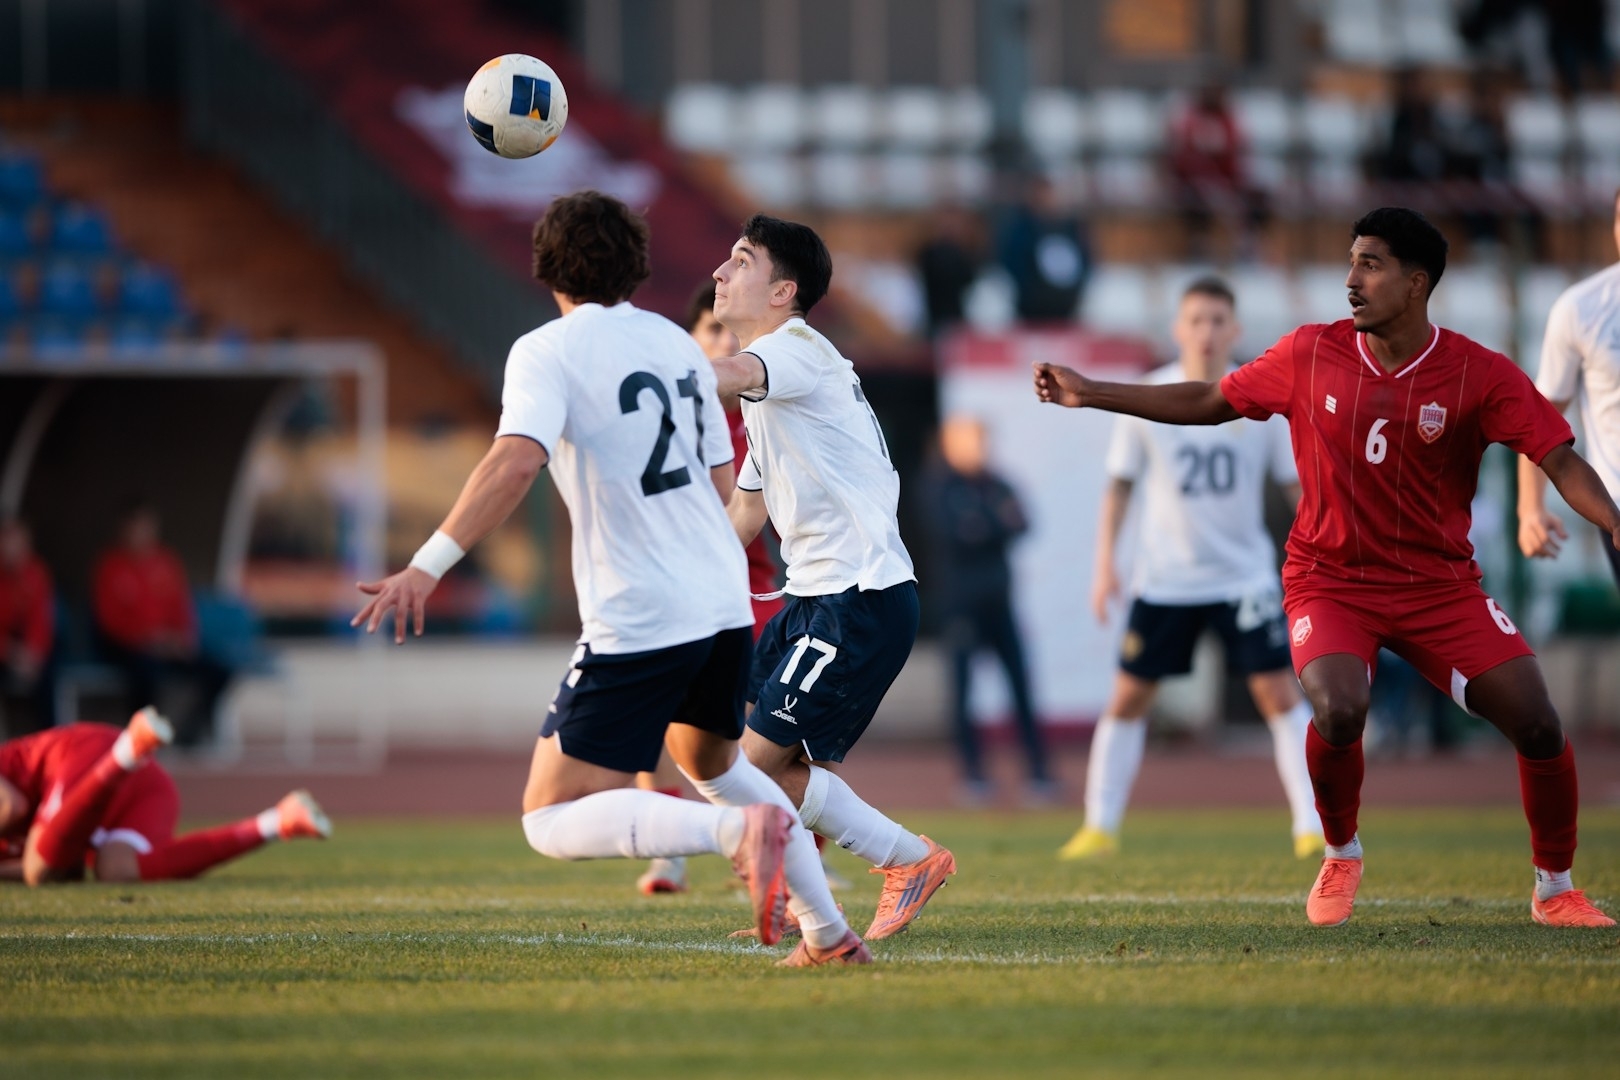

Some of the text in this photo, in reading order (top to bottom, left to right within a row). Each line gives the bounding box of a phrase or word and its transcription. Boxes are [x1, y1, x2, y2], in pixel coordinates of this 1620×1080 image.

[618, 369, 705, 497] 21
[1365, 418, 1389, 465] 6
[1177, 447, 1236, 494] 20
[1485, 598, 1517, 635] 6
[780, 633, 837, 693] 17
